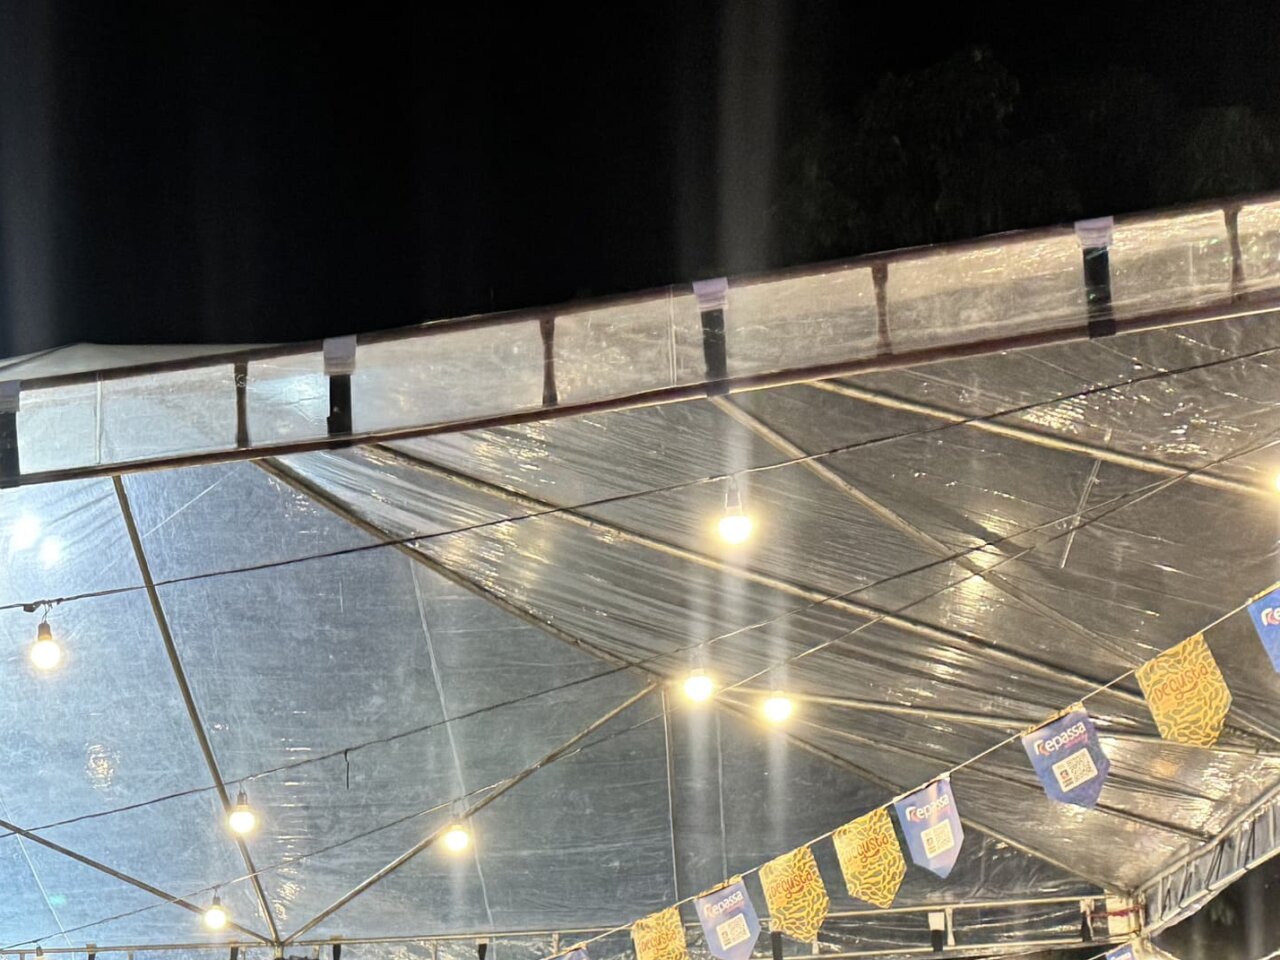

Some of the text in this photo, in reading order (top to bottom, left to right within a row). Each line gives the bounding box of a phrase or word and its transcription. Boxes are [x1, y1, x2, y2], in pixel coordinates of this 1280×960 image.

[1153, 662, 1209, 702] Degusta
[1033, 722, 1087, 756] Repassa
[905, 794, 949, 822] Repassa
[770, 871, 814, 899] Degusta
[704, 890, 744, 918] Repassa
